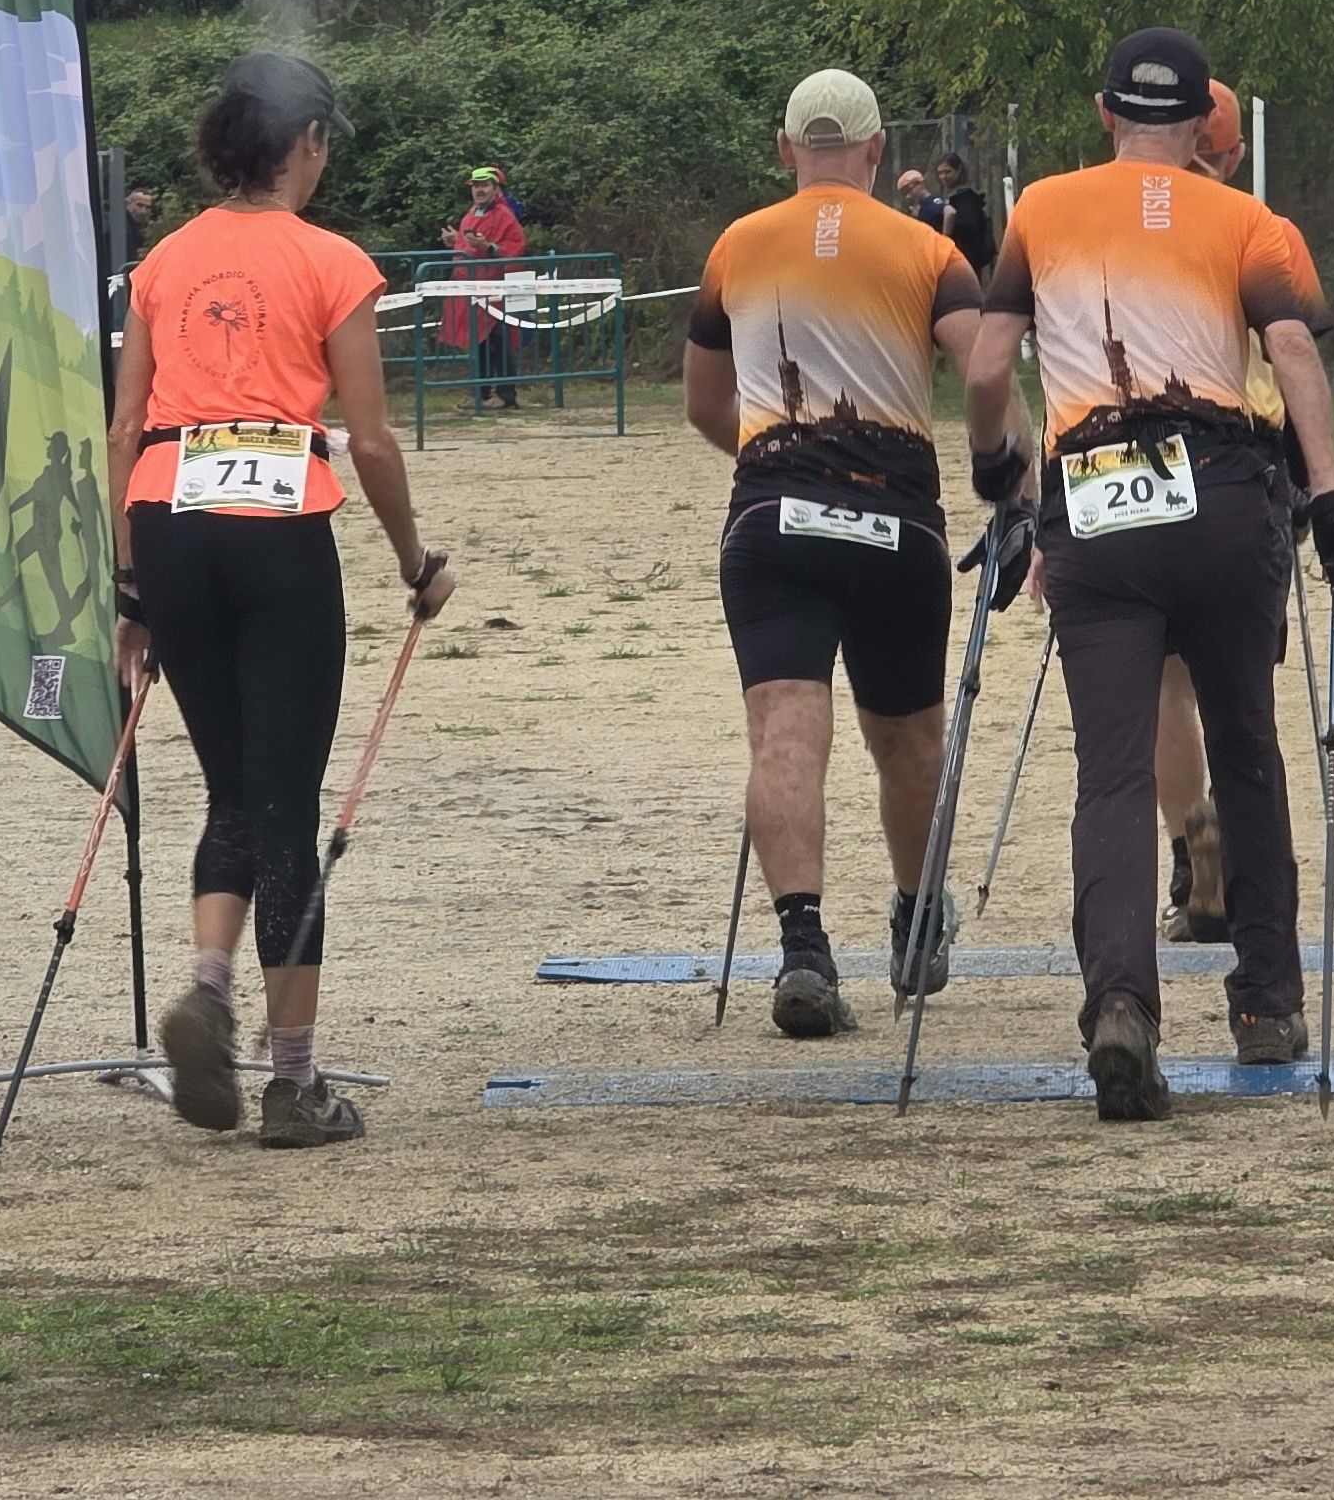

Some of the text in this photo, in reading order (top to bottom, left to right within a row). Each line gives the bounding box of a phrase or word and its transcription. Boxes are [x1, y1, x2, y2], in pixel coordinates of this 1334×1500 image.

[1142, 190, 1171, 229] OTSO
[814, 219, 841, 258] OTSO
[216, 459, 263, 487] 71
[1104, 475, 1155, 510] 20
